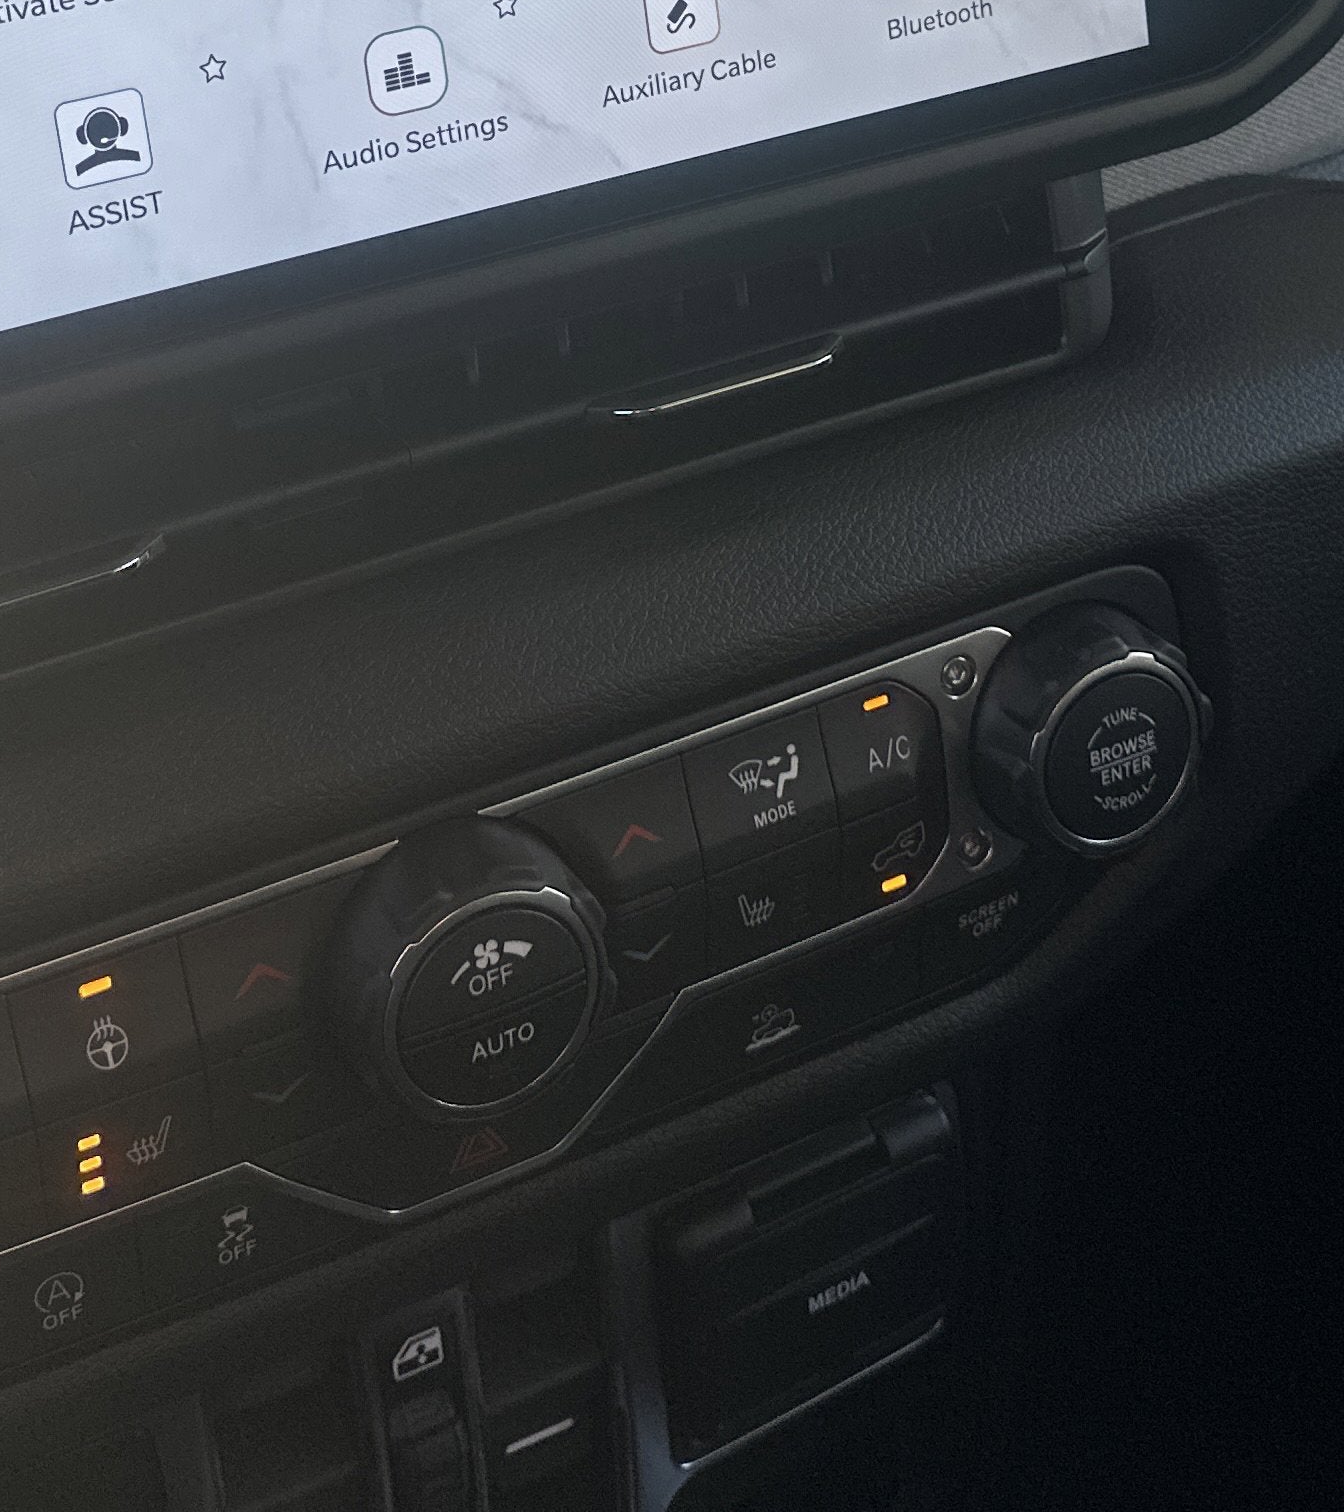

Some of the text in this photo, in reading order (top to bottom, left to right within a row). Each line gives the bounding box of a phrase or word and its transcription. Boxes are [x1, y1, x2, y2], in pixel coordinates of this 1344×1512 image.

[601, 47, 777, 109] Auxiliary Cable
[322, 112, 509, 176] Audio Settings
[67, 190, 164, 236] ASSIST
[1102, 706, 1139, 730] TUNE
[866, 734, 911, 773] A/C
[1089, 728, 1156, 768] BROWSE
[1101, 754, 1153, 787] ENTER
[753, 800, 798, 829] MODE
[959, 890, 1019, 929] SCREEN
[972, 916, 1003, 938] OFF
[468, 963, 515, 997] OFF
[471, 1021, 536, 1063] AUTO
[218, 1239, 257, 1265] OFF
[807, 1270, 872, 1315] MEDIA
[43, 1303, 85, 1331] OFF
